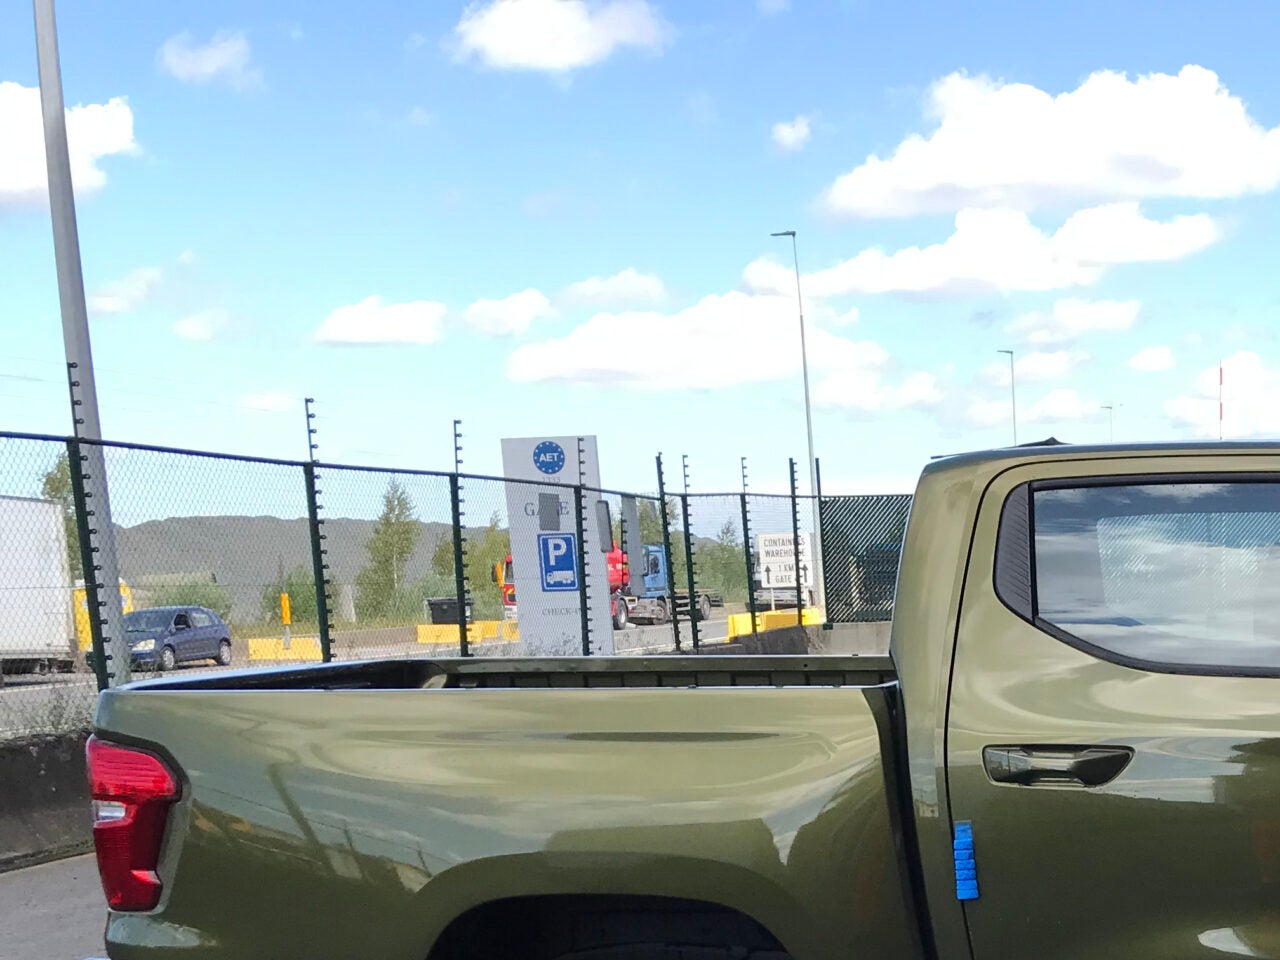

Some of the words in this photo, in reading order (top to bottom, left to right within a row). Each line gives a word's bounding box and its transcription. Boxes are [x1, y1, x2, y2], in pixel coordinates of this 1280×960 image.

[539, 452, 559, 462] AET
[524, 502, 570, 516] GE
[547, 538, 567, 566] P
[775, 574, 792, 584] GATE
